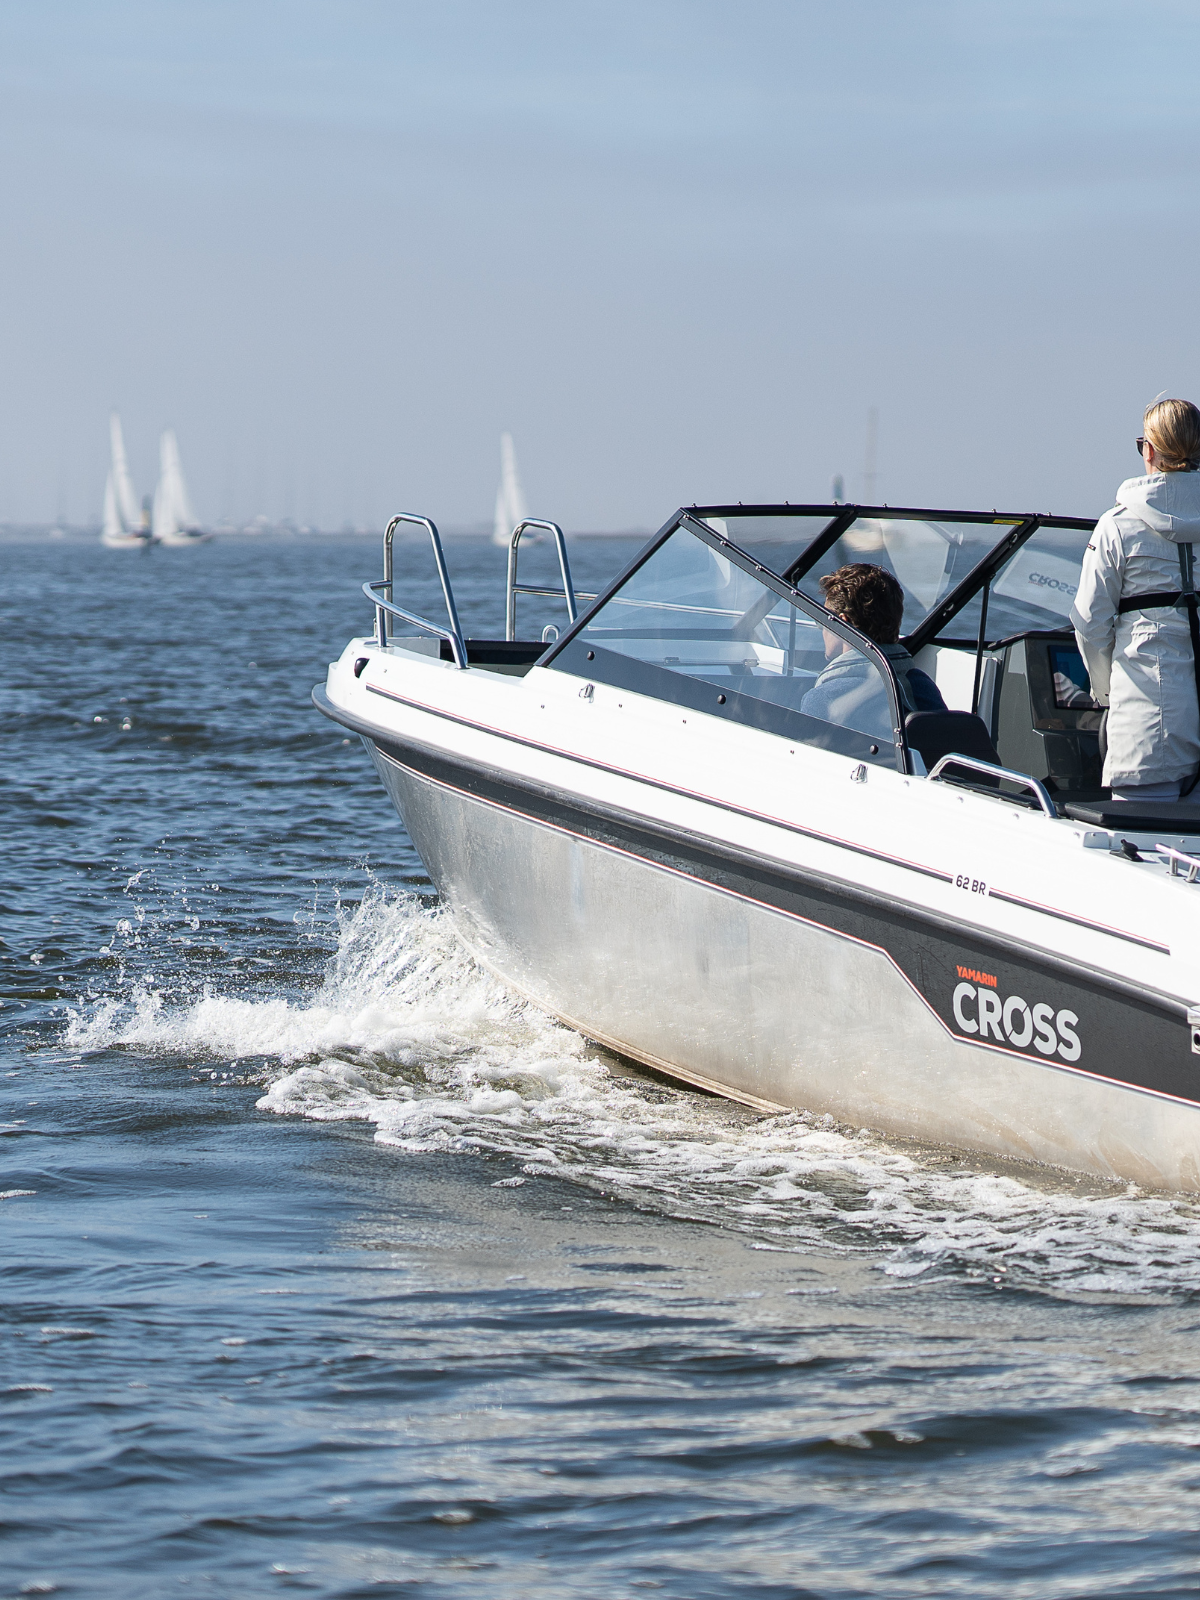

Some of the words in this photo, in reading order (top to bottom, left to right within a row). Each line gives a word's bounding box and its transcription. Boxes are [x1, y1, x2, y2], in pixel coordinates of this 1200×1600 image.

[956, 874, 970, 890] 62
[971, 879, 986, 896] BR
[956, 965, 997, 988] YAMARIN
[953, 982, 1082, 1062] CROSS
